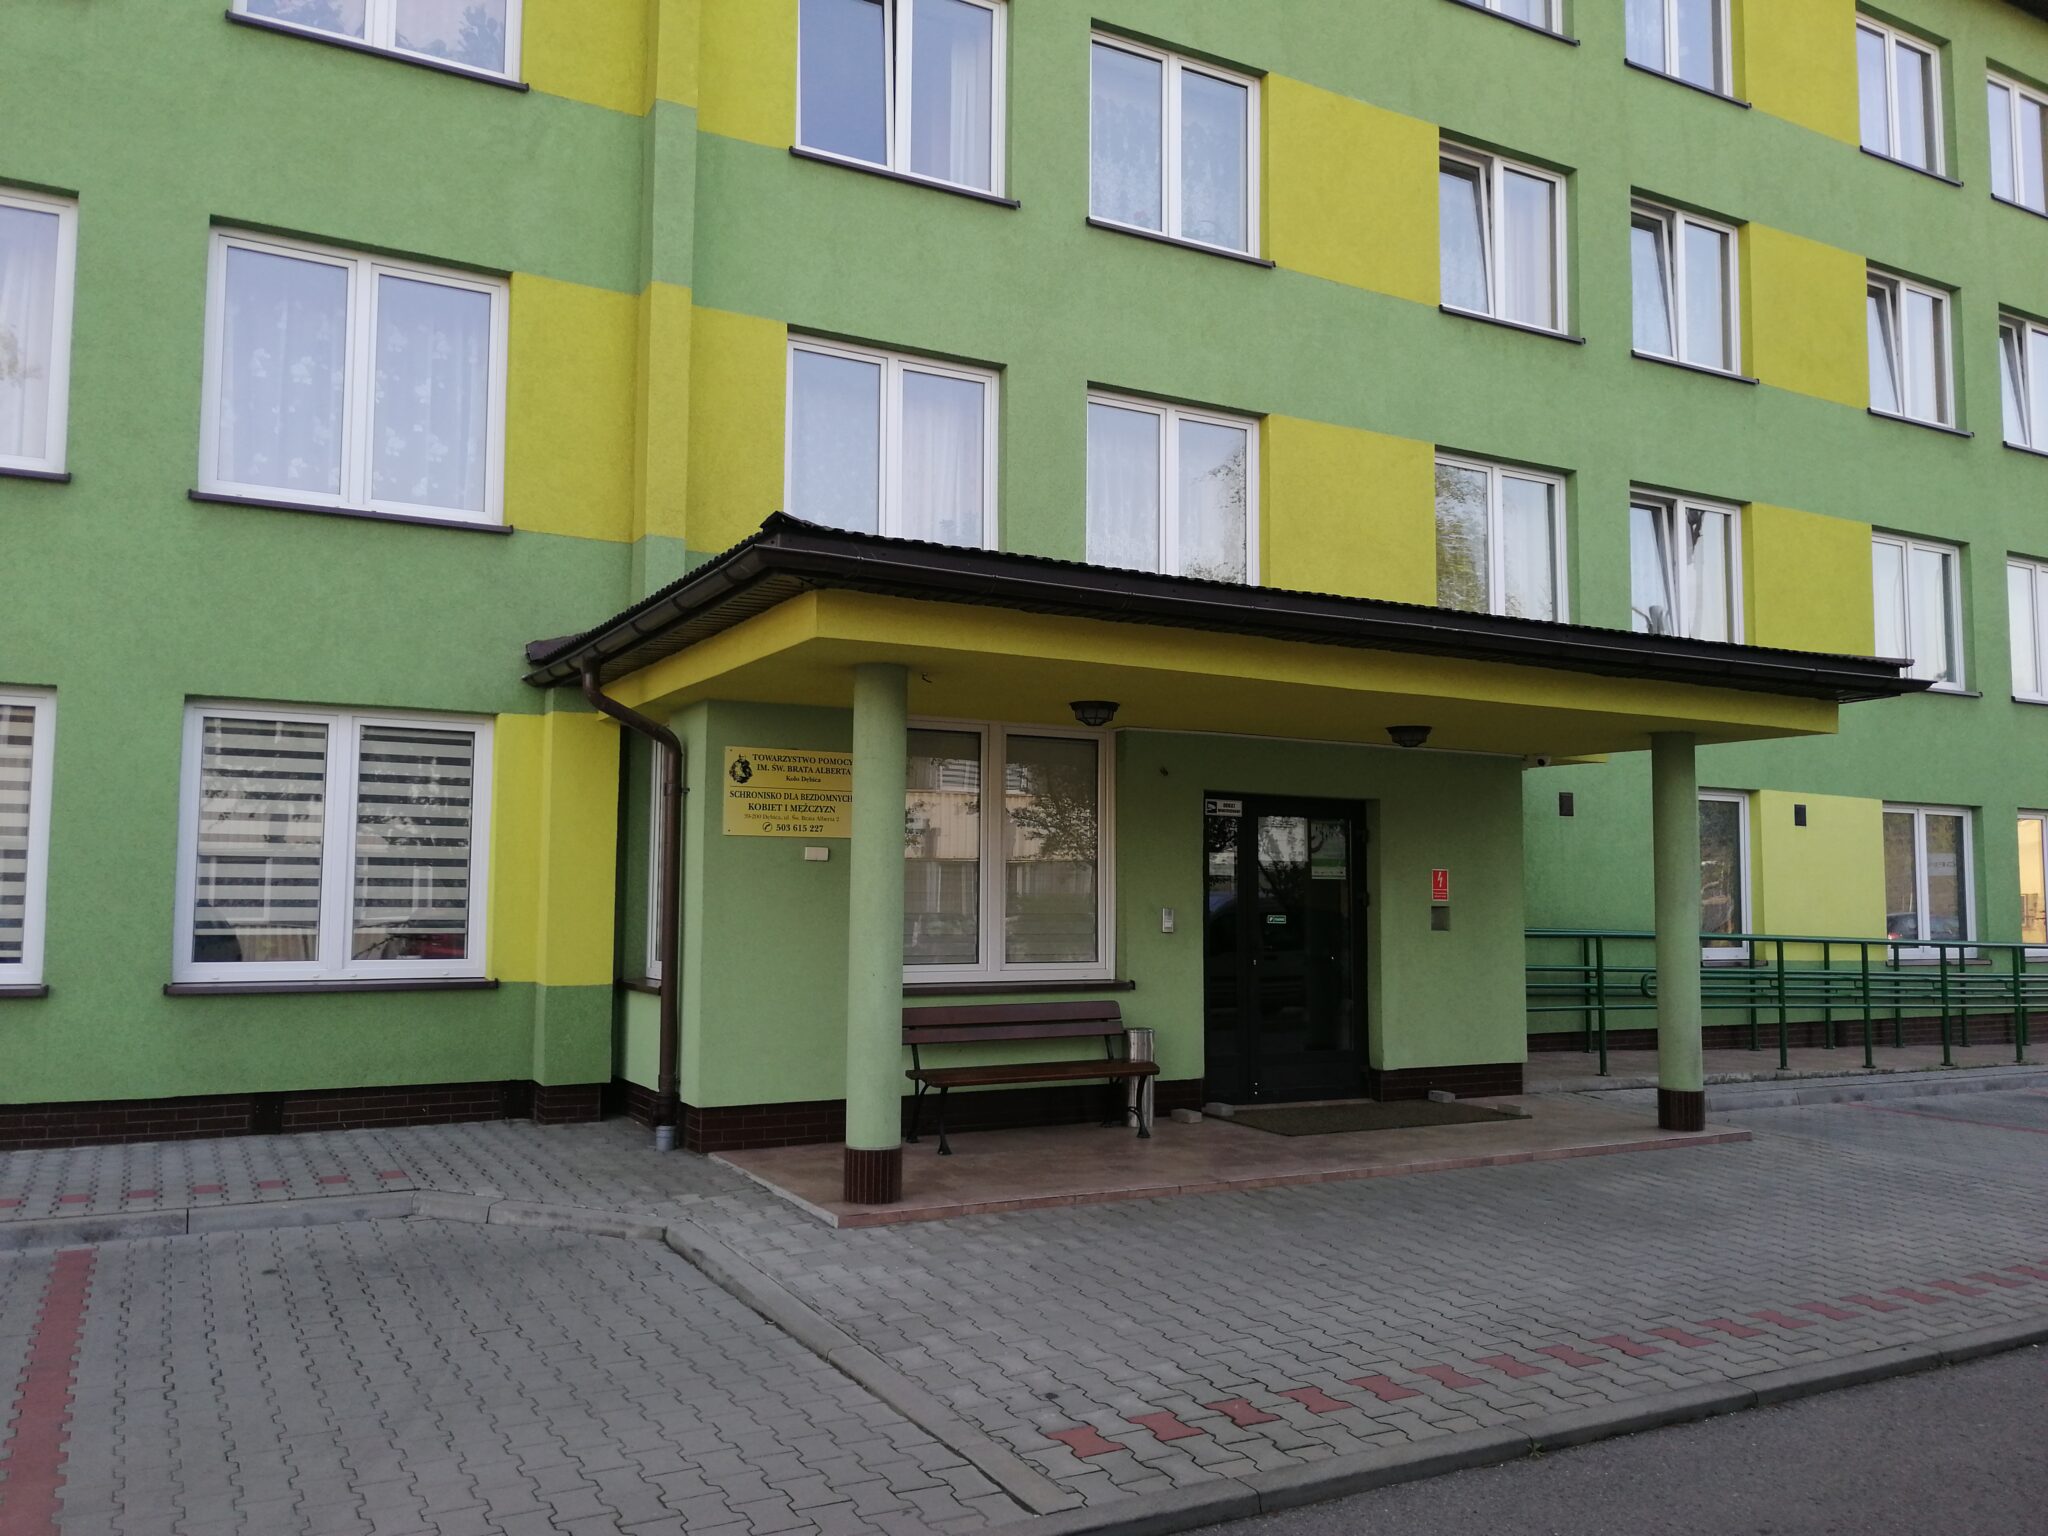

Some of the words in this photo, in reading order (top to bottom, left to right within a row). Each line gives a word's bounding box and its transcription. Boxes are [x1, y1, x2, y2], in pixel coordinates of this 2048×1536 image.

[752, 754, 816, 764] TOWARZYSTWO
[818, 757, 853, 766] POMOCY
[771, 763, 785, 772] ŚW.
[787, 765, 812, 774] BRATA
[815, 767, 851, 776] ALBERTA
[730, 791, 782, 800] SCHRONISKO
[800, 793, 853, 803] BEZDOMNYCH
[748, 803, 782, 811] KOBIET
[790, 803, 836, 813] MĘŻCZYZN
[793, 824, 807, 832] 615
